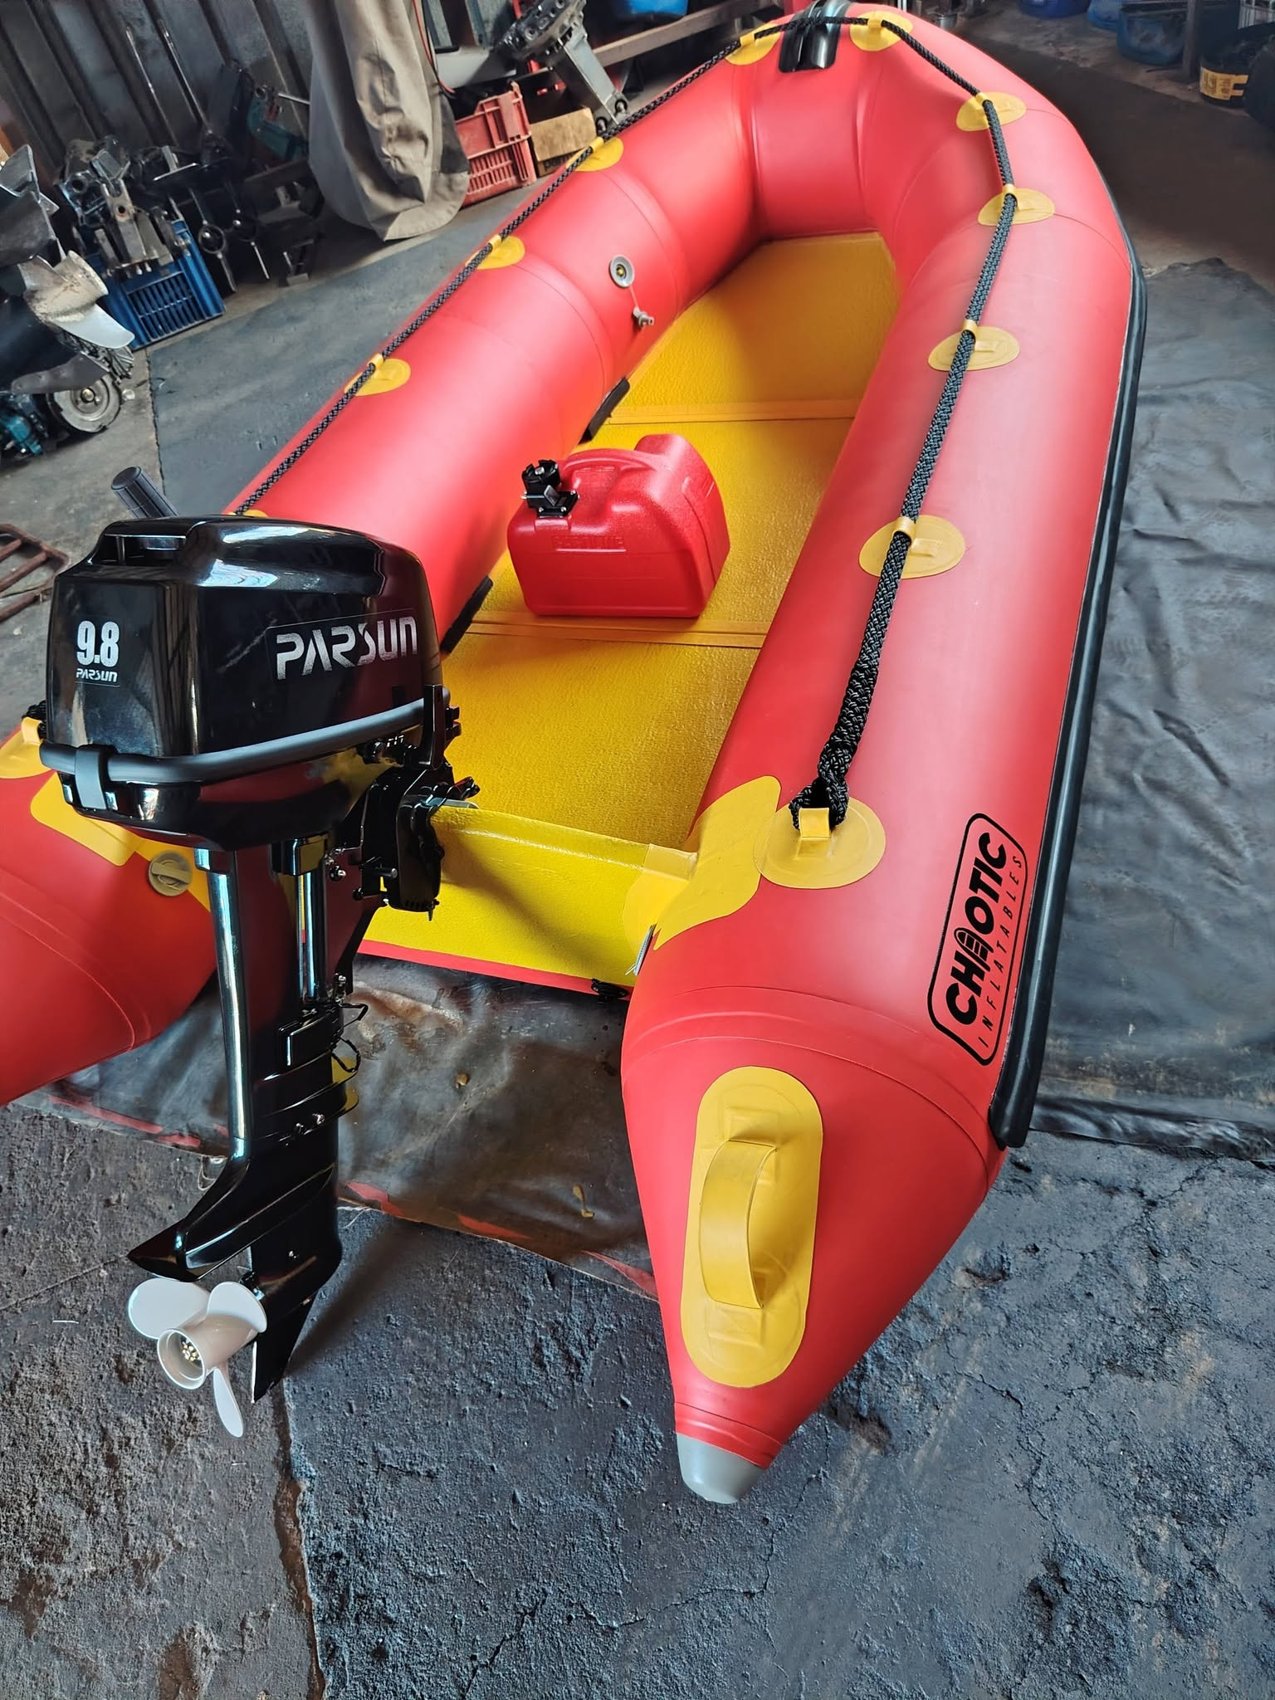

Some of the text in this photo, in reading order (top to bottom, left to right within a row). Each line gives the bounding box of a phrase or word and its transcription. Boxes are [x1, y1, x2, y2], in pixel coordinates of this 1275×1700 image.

[75, 668, 118, 683] PARSUN
[76, 620, 120, 667] 9.8
[276, 616, 418, 680] PARSUN
[945, 832, 1008, 1026] CHAOTIC
[978, 855, 1023, 1049] INFLATABLES
